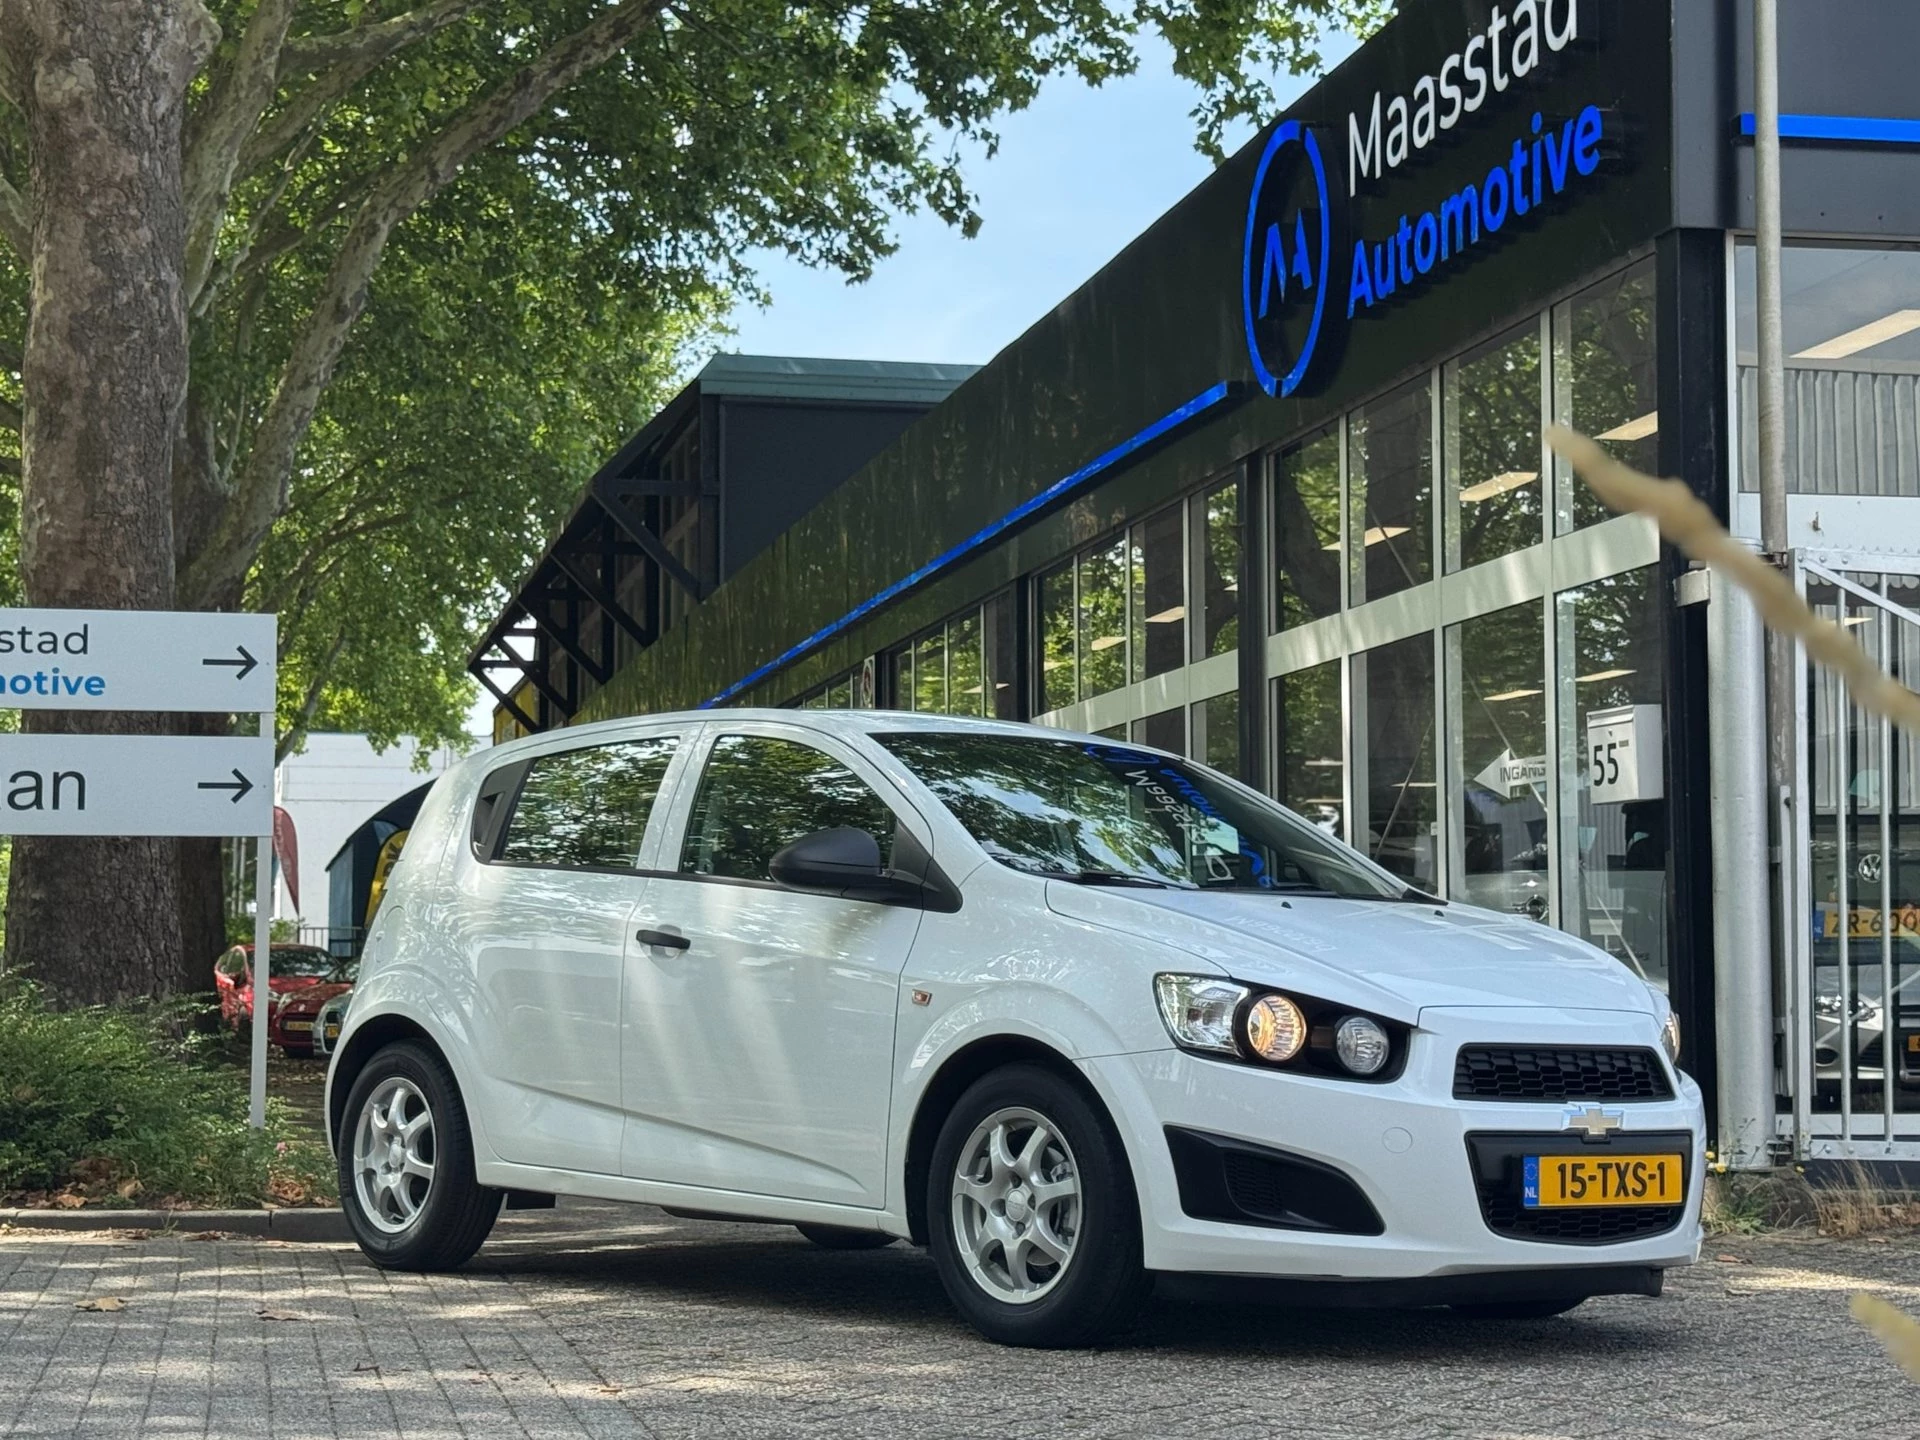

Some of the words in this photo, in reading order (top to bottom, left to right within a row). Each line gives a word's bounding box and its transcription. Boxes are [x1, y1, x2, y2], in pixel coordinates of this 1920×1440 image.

[1347, 104, 1603, 319] Automotive
[0, 667, 106, 696] otive
[1592, 742, 1619, 787] 55
[1524, 1186, 1538, 1199] NL
[1557, 1161, 1666, 1199] 15-TXS-1
